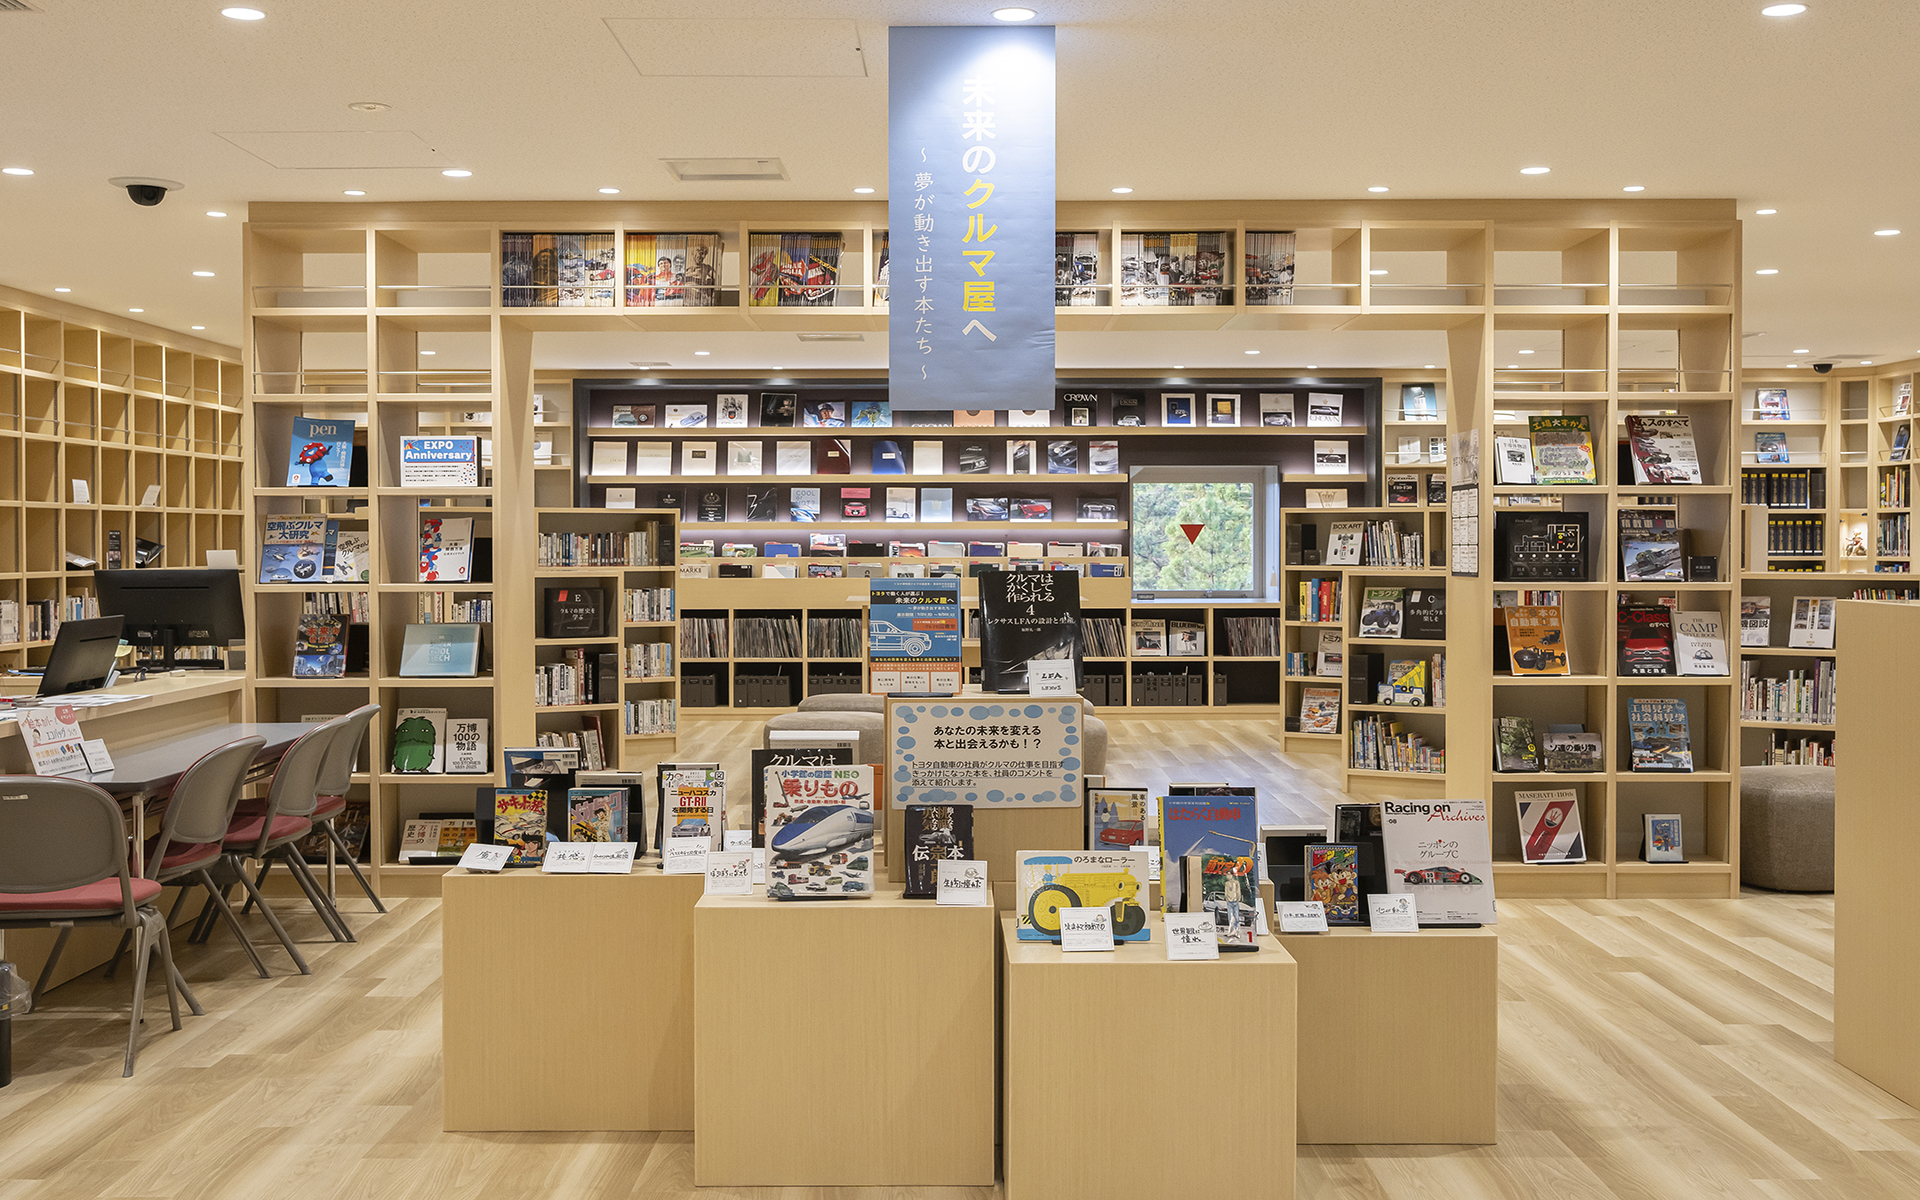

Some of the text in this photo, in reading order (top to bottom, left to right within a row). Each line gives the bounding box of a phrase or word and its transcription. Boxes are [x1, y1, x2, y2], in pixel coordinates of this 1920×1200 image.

[962, 76, 997, 342] 未来のクルマ屋へ
[1063, 393, 1097, 402] CROWN
[1309, 415, 1340, 423] CROWN
[309, 424, 337, 438] pen
[423, 441, 454, 450] EXPO
[405, 451, 473, 461] Anniversary
[267, 521, 324, 531] 空飛ぶクルマ
[278, 530, 310, 540] 大研究
[1006, 573, 1054, 583] クルマは
[1006, 582, 1054, 593] かくして
[575, 594, 581, 602] E
[1006, 592, 1055, 603] 作られる
[1427, 595, 1435, 603] C
[1026, 604, 1036, 616] 4
[1510, 617, 1560, 627] 自動車工業
[1617, 611, 1669, 623] C-Class
[1679, 622, 1718, 633] CAMP
[1630, 704, 1674, 713] 工場見学
[1631, 713, 1686, 722] 社会科見学
[456, 723, 478, 733] 万博
[933, 725, 1042, 737] あなたの未来を変える
[453, 733, 480, 742] 100の
[456, 741, 477, 751] 物語
[933, 738, 1042, 750] 本と出会えるかも！？
[1550, 744, 1597, 752] ソ連の乗り物
[911, 760, 1065, 769] トヨタ自動車の社員がクルマの仕事を目指す
[781, 770, 860, 779] 小学館の図鑑 NEO
[911, 769, 1054, 779] きっかけになった本を、社員のコメントを
[911, 778, 978, 787] 添えて紹介します。
[782, 779, 859, 798] 乗りもの
[1384, 801, 1430, 815] Racing
[1434, 803, 1452, 813] on
[1427, 804, 1486, 822] Archives
[1168, 807, 1242, 821] はたらく自動車
[1418, 840, 1459, 849] ニッポンの
[912, 845, 931, 861] 伝
[1420, 850, 1459, 858] グループC
[1073, 856, 1136, 864] のろまなローラー
[1247, 931, 1253, 943] 1
